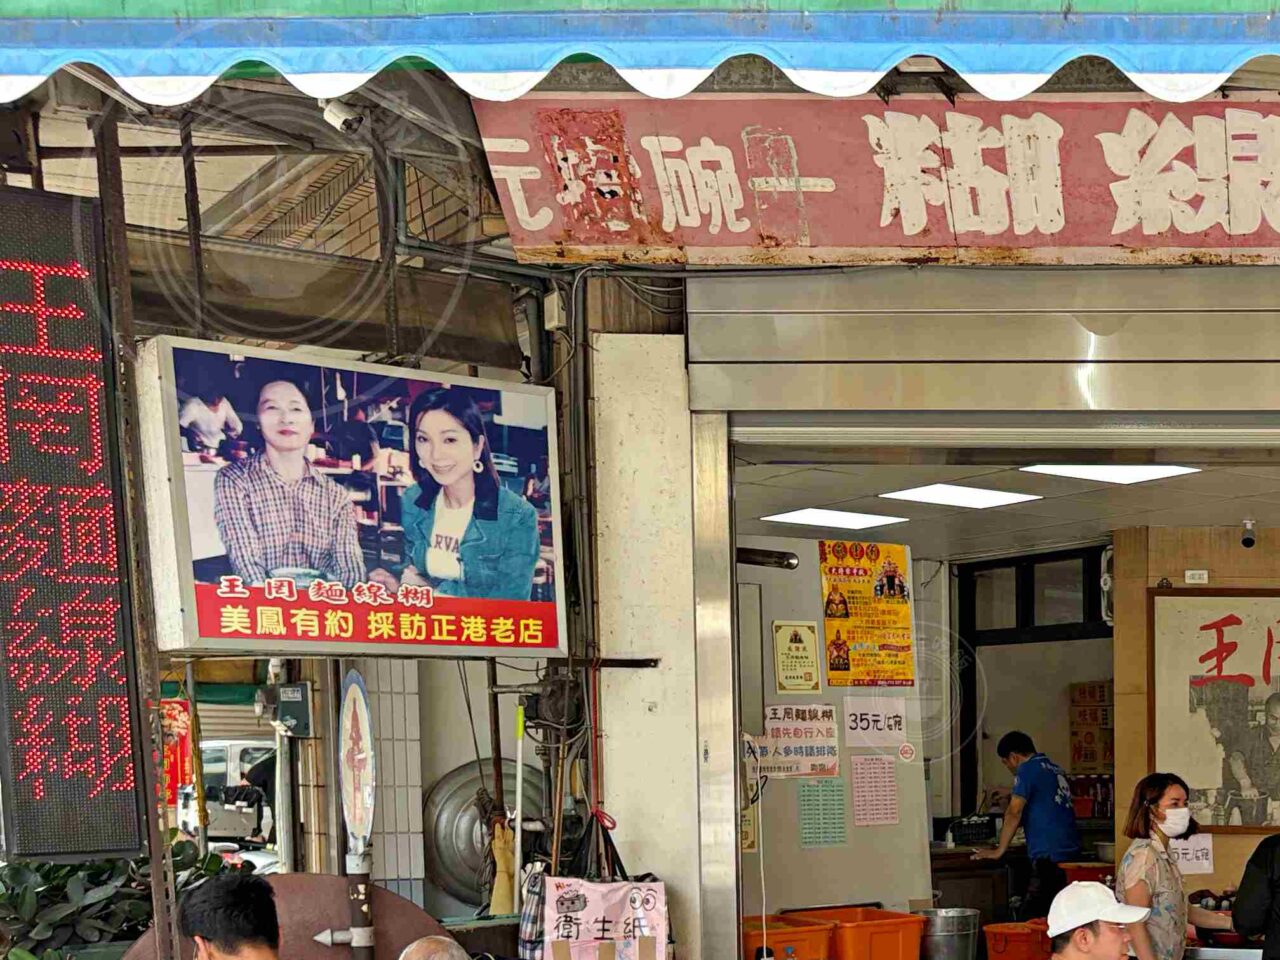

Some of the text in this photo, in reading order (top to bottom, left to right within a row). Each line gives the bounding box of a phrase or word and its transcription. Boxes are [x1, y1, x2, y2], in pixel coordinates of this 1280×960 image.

[216, 575, 434, 608] 王罔麵線糊
[219, 605, 544, 645] 美鳳有約 採訪正港老店
[849, 713, 902, 731] 35元/碗
[554, 914, 650, 941] 衛生紙
